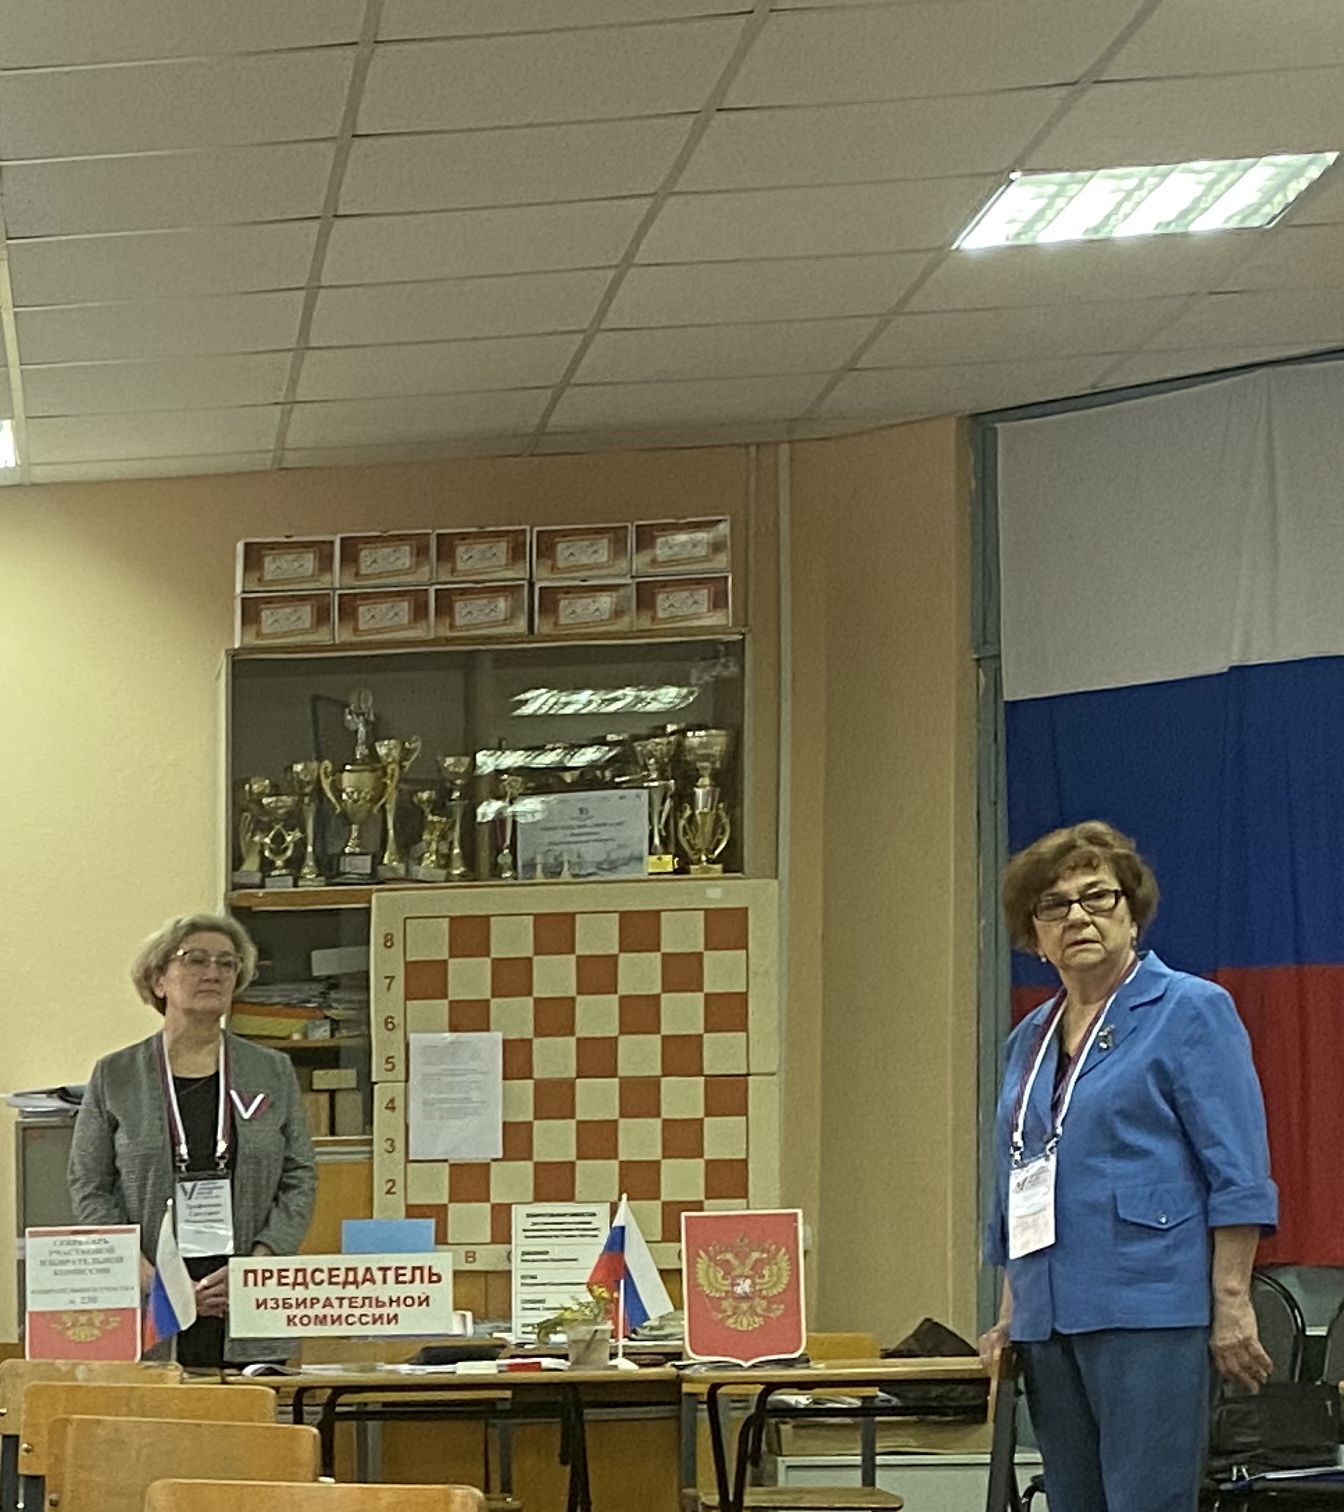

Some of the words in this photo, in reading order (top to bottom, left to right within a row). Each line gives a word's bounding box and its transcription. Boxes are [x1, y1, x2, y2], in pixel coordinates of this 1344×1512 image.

[383, 932, 395, 949] 8
[383, 975, 396, 992] 7
[384, 1015, 396, 1031] 6
[384, 1055, 396, 1072] 5
[384, 1097, 396, 1113] 4
[384, 1137, 396, 1154] 3
[384, 1179, 397, 1195] 2
[242, 1265, 443, 1290] ПРЕДСЕДАТЕЛЬ
[255, 1291, 431, 1310] ИЗБИРАТЕЛЬНОЙ
[286, 1312, 400, 1327] КОМИССИИ
